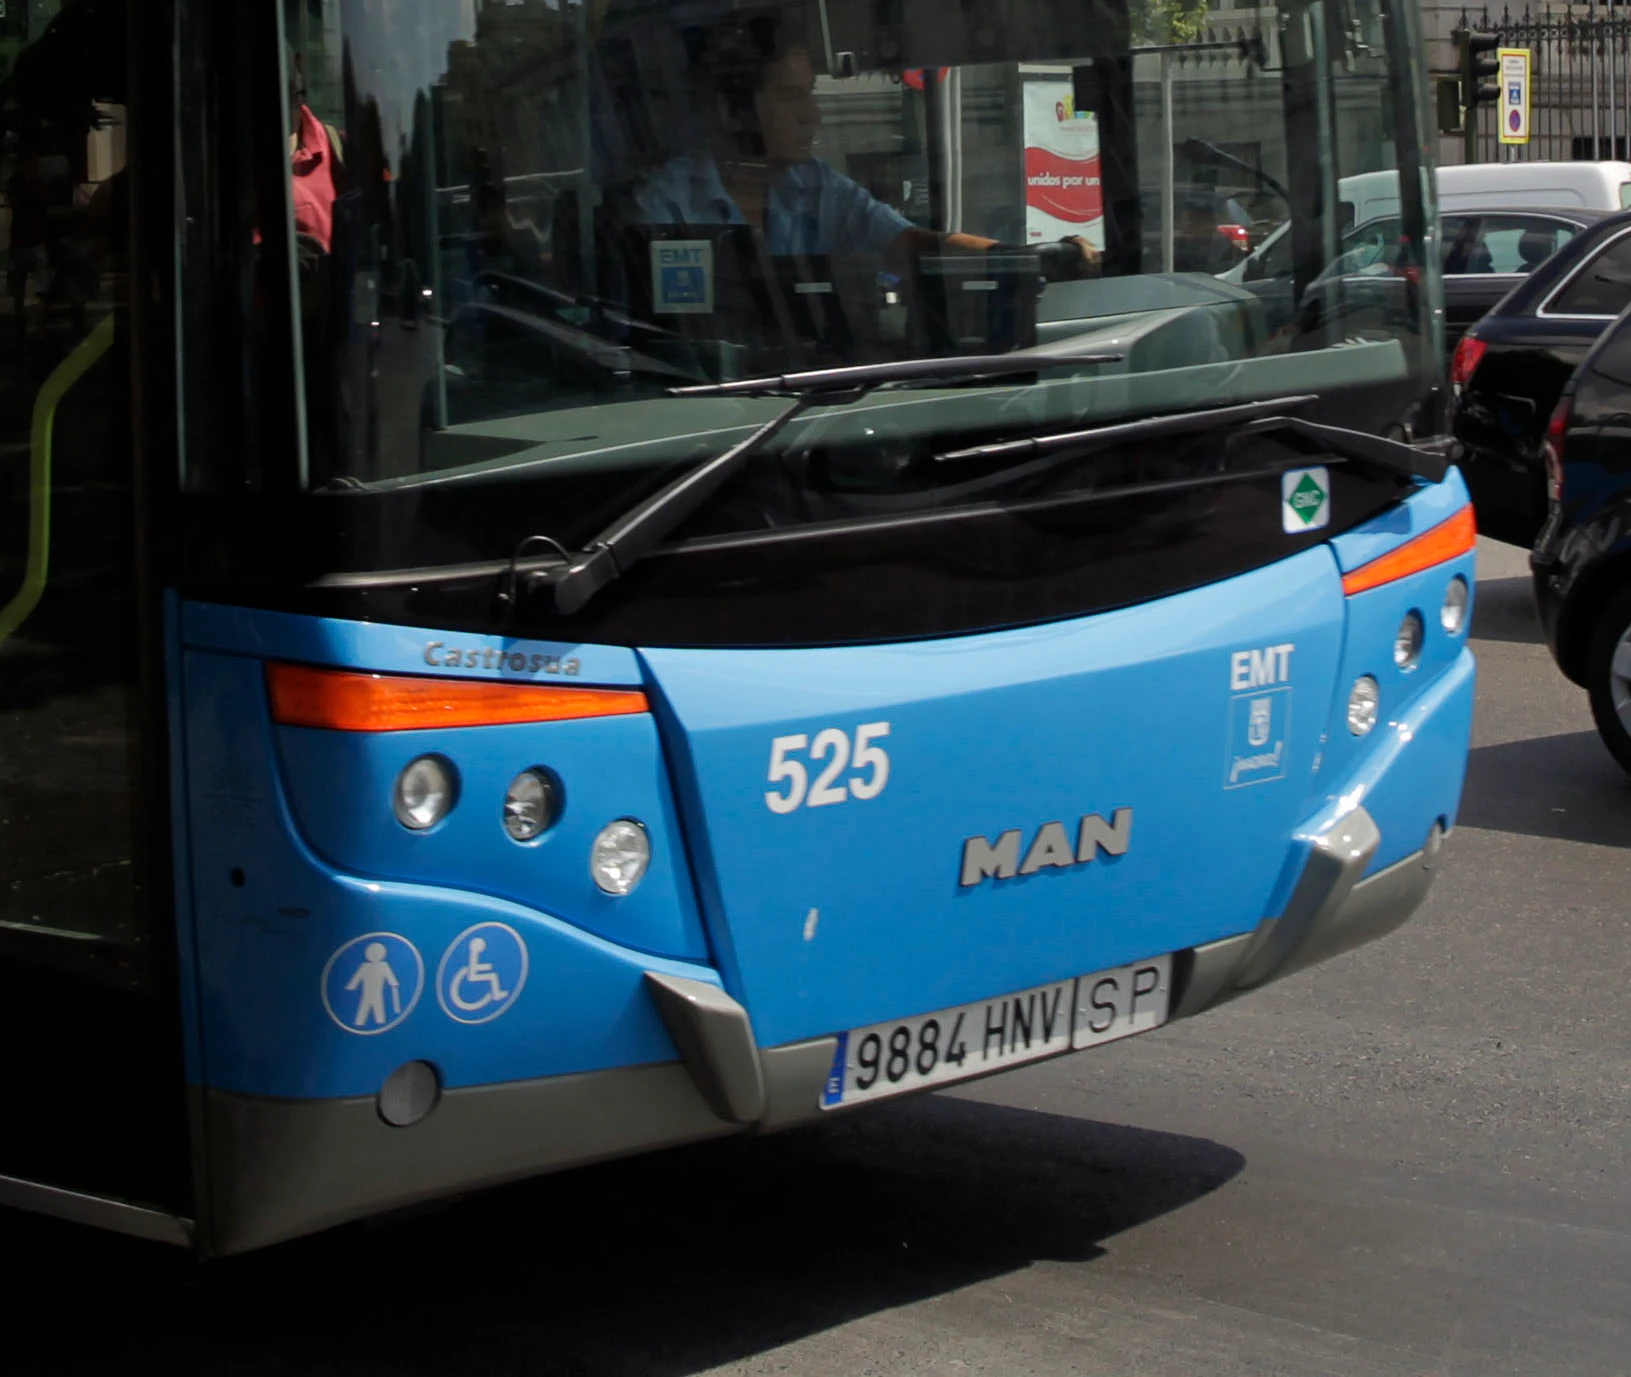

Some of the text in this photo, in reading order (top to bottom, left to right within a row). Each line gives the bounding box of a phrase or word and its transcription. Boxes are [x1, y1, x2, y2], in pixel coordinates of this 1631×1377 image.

[1027, 172, 1060, 186] unidos
[1062, 175, 1083, 189] por
[423, 640, 582, 676] Castrosua
[1229, 642, 1295, 691] EMT
[765, 721, 891, 814] 525
[958, 807, 1134, 889] MAN
[855, 1011, 967, 1091] 9884
[981, 986, 1064, 1062] HNV
